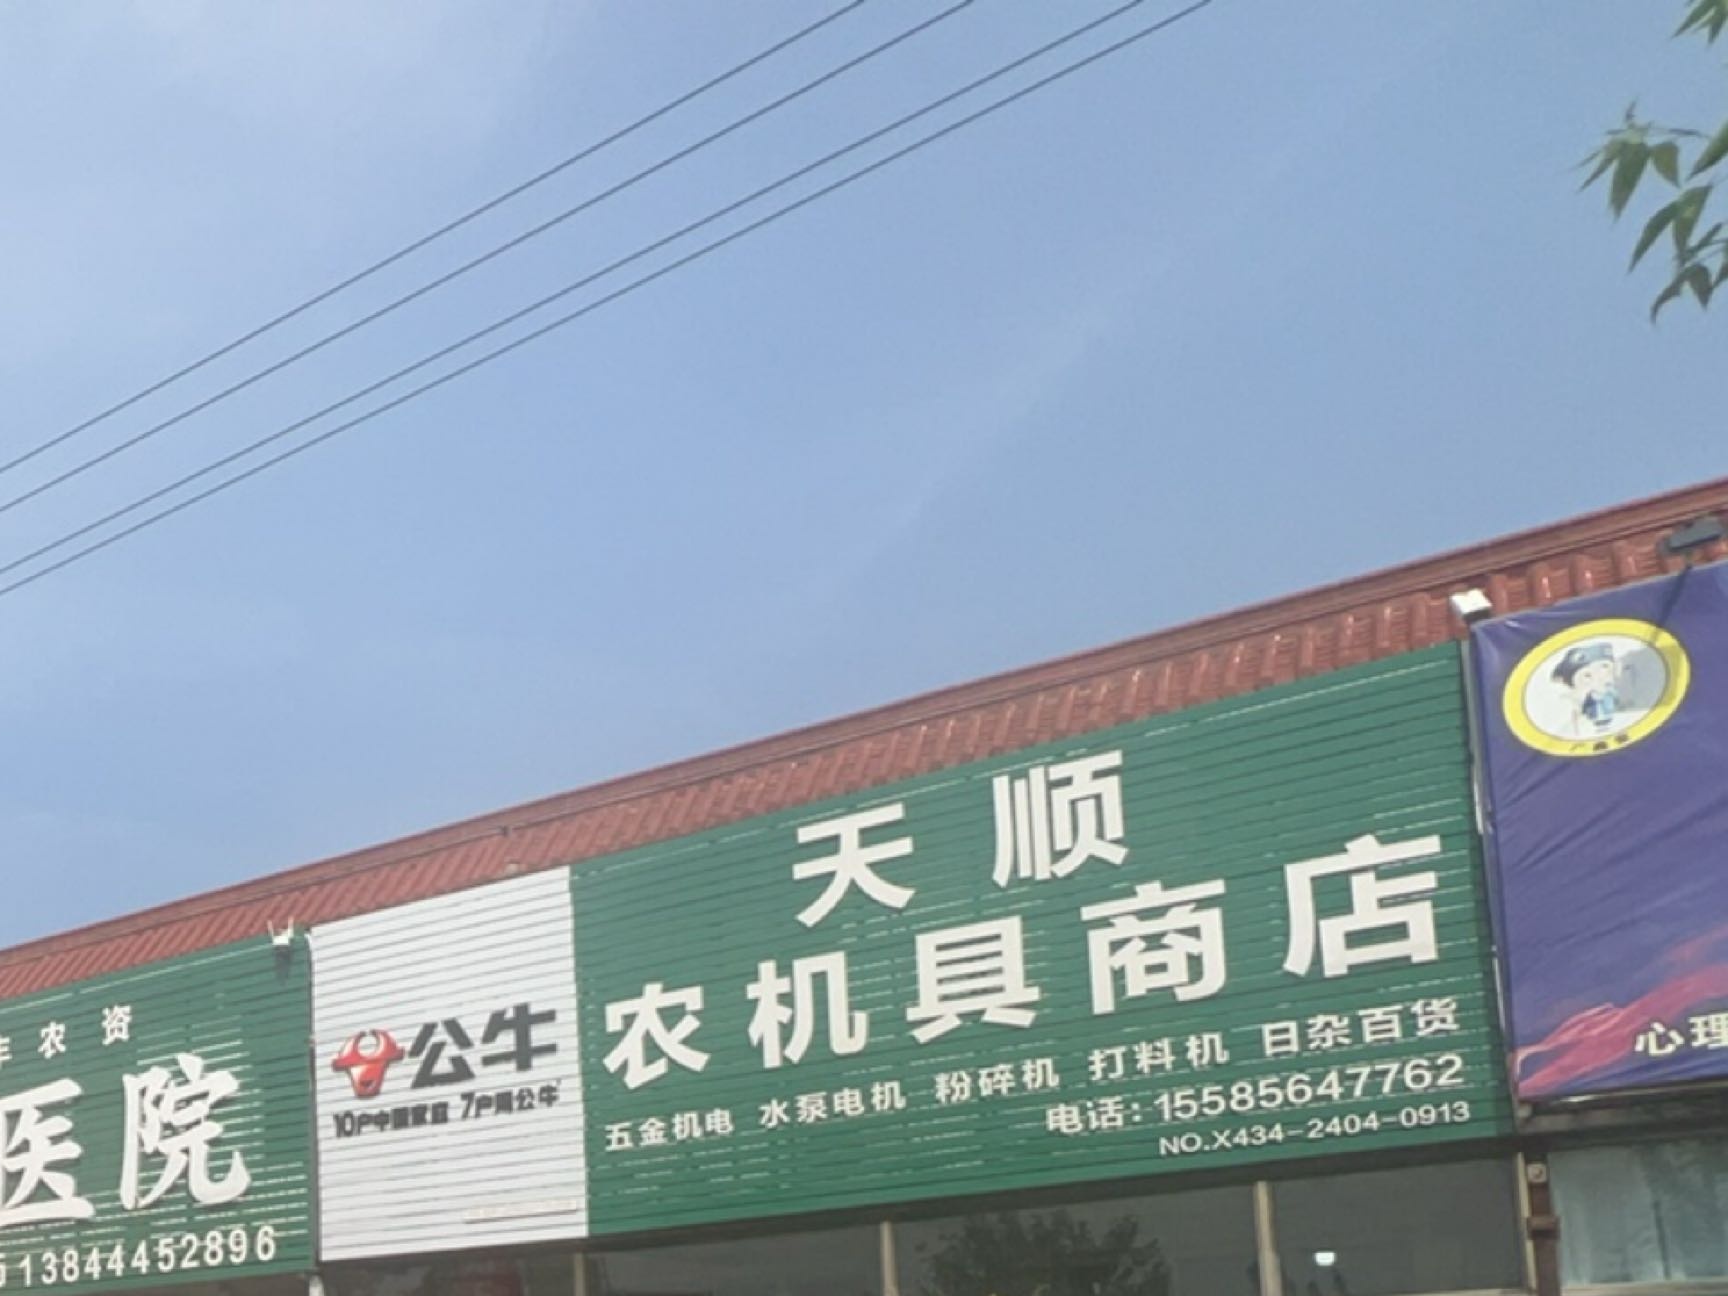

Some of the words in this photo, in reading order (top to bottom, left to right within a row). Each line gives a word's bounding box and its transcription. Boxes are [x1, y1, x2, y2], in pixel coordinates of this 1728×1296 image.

[791, 749, 1130, 927] 天顺
[602, 834, 1443, 1091] 农机具商店
[408, 1002, 558, 1089] 公牛
[604, 1105, 734, 1153] 五金机电
[759, 1079, 907, 1131] 水泵电机
[935, 1057, 1060, 1103] 粉碎机
[1088, 1033, 1230, 1080] 打料机
[1261, 998, 1461, 1057] 日杂百货
[1634, 1013, 1728, 1057] 心理
[1158, 1101, 1471, 1156] NO.X434-2404-0913
[19, 1225, 277, 1288] 13844452896
